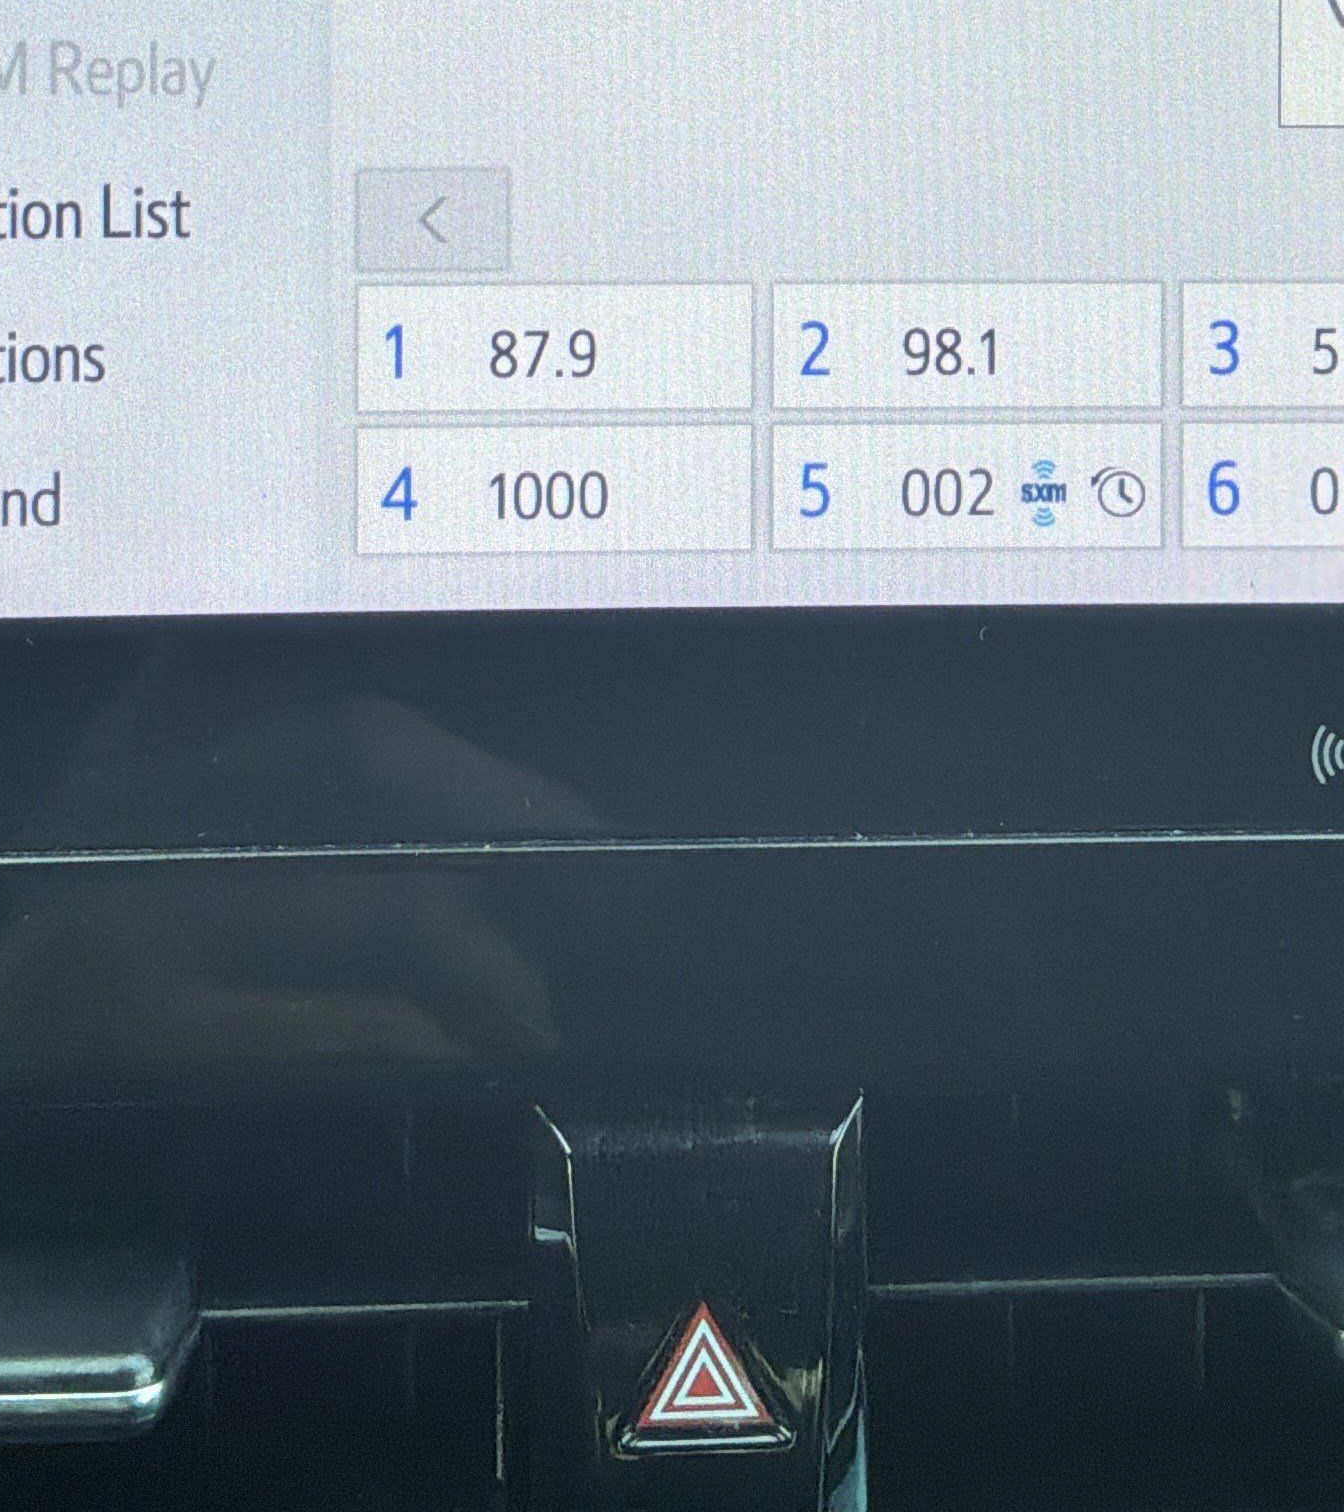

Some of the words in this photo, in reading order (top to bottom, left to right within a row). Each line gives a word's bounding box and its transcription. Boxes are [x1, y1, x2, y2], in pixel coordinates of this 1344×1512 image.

[49, 39, 216, 108] Replay
[103, 184, 190, 239] List
[386, 325, 402, 378] 1
[490, 329, 596, 378] 87.9
[801, 321, 829, 376] 2
[903, 328, 995, 376] 98.1
[1210, 320, 1239, 375] 3
[381, 467, 416, 520] 4
[490, 471, 608, 520] 1000
[801, 463, 830, 517] 5
[902, 468, 993, 517] 002
[1208, 461, 1239, 515] 6
